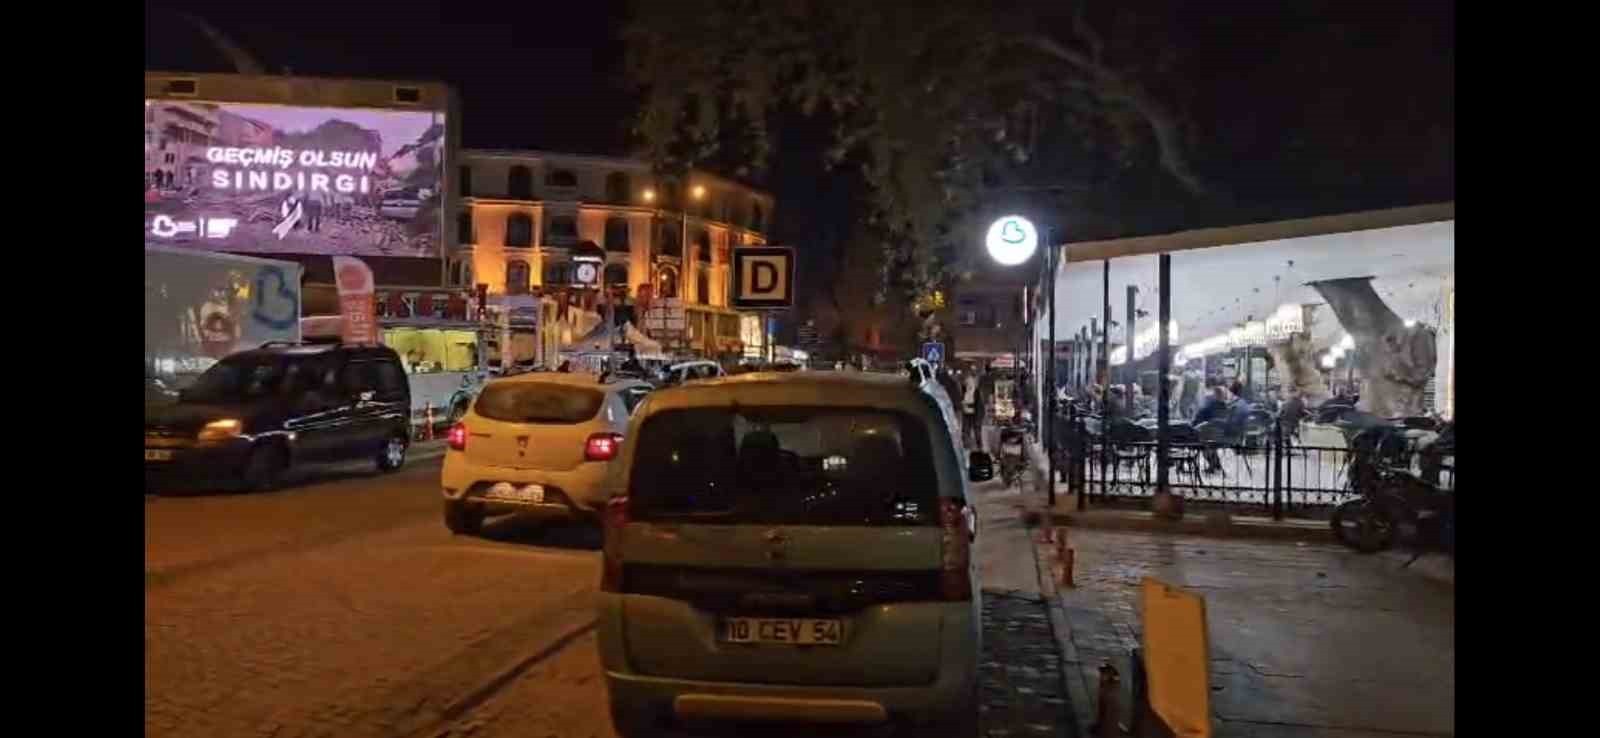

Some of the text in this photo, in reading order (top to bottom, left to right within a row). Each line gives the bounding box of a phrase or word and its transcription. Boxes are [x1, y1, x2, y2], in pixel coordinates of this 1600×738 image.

[206, 146, 377, 169] GEÇMİŞ OLSUN
[211, 169, 369, 193] SINDIRGI
[751, 260, 778, 294] D
[731, 620, 837, 641] 10 CEV 54
